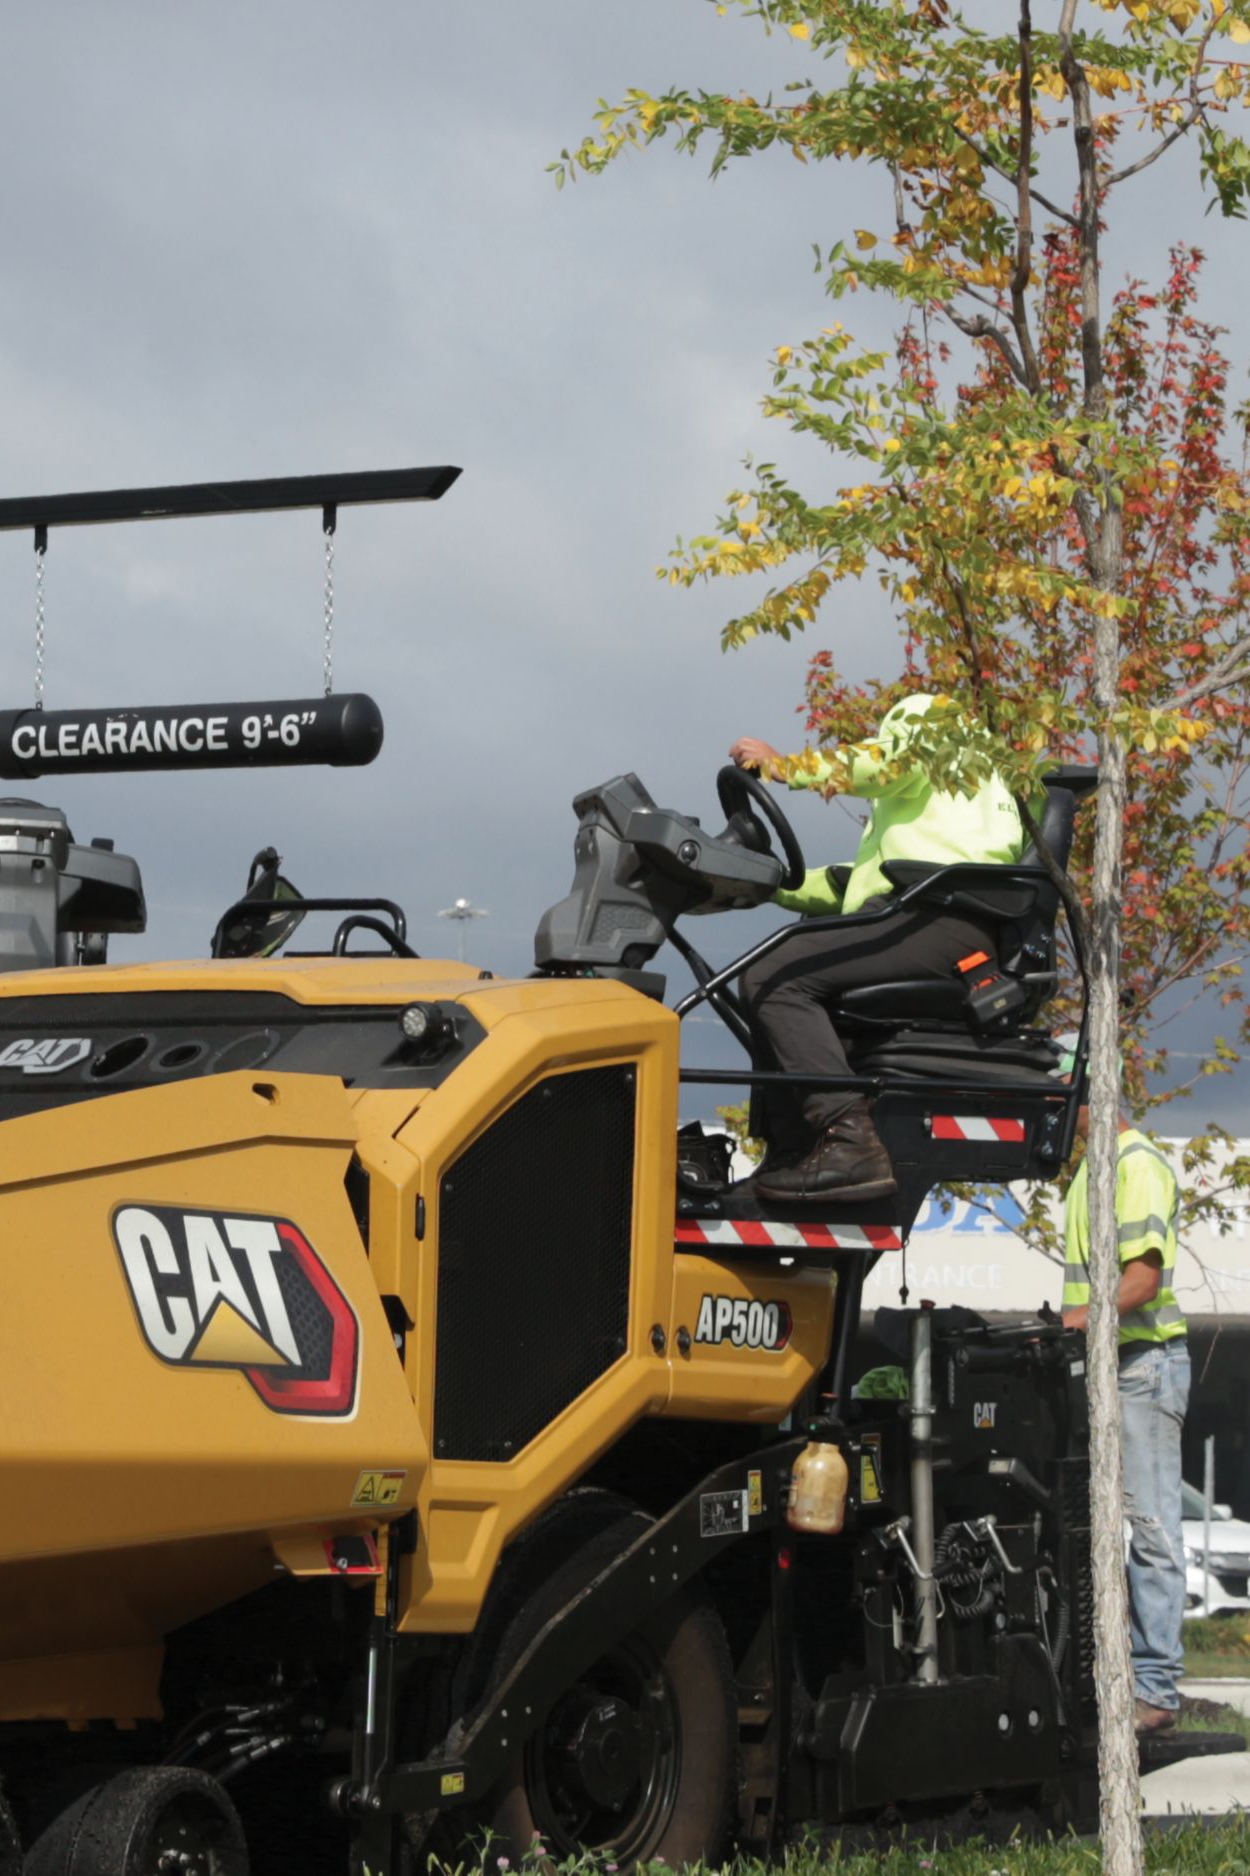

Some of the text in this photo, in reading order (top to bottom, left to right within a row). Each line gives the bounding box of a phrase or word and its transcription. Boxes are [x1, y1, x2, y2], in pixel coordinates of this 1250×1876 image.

[11, 717, 229, 759] CLEARANCE
[115, 1207, 302, 1366] CAT
[695, 1296, 779, 1348] AP500
[974, 1402, 997, 1428] CAT
